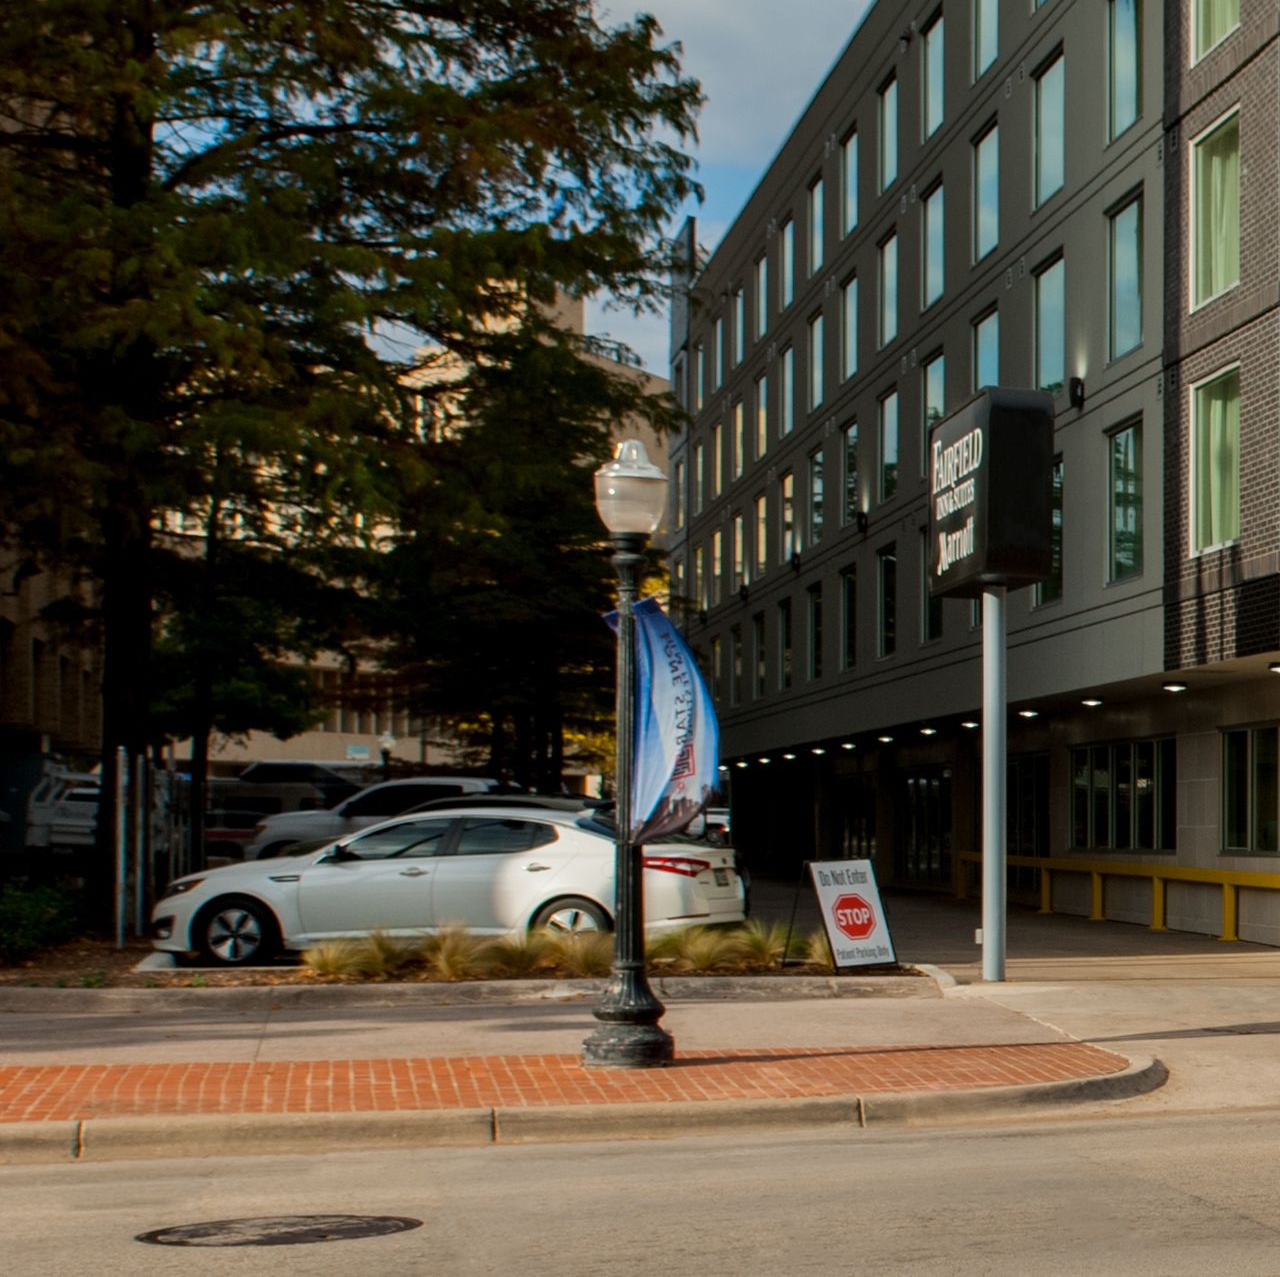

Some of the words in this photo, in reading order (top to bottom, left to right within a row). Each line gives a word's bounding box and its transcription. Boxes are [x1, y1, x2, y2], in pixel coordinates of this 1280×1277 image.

[933, 429, 983, 494] FAIRFIELD
[954, 479, 975, 509] SUITES
[937, 516, 973, 576] Marriott
[818, 871, 832, 886] Do
[832, 870, 846, 885] Not
[846, 869, 868, 884] Enter
[837, 908, 870, 926] STOP
